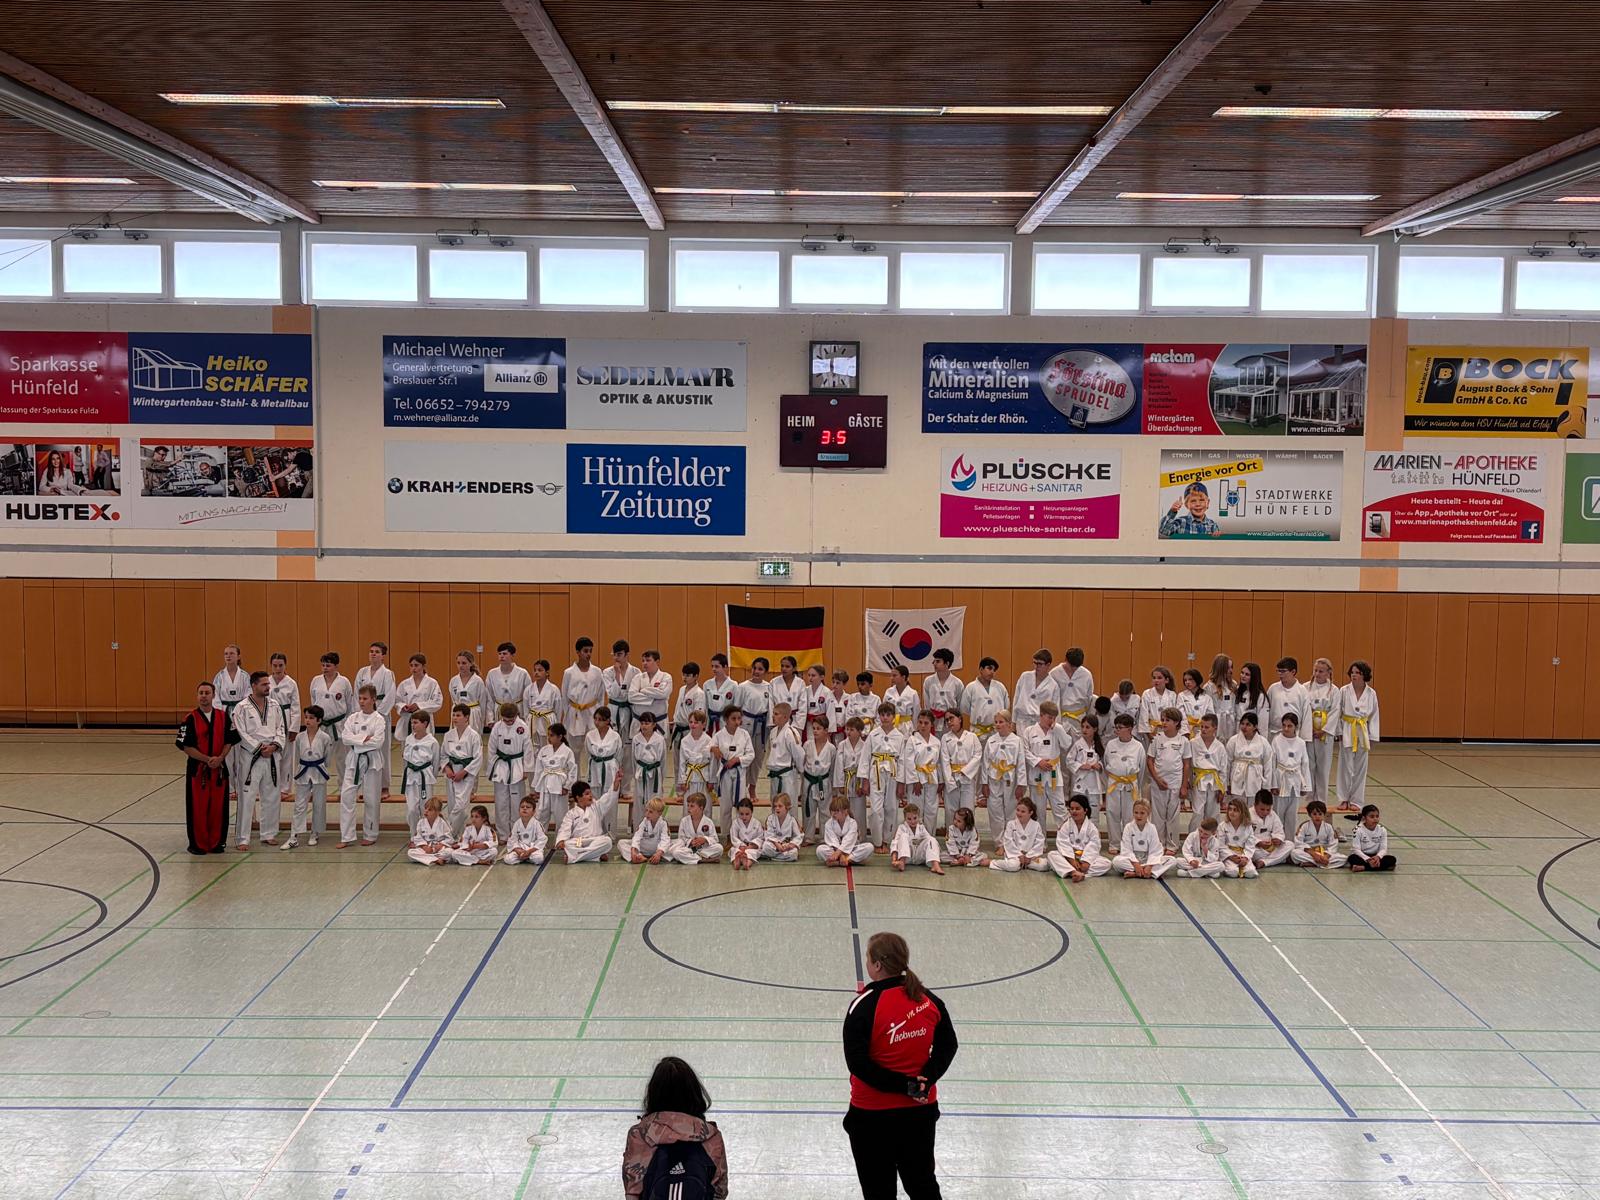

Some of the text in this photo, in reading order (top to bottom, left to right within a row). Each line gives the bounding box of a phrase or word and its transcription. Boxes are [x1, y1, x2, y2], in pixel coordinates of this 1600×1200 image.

[393, 342, 505, 358] Michael Wehner
[1151, 349, 1195, 363] metam
[9, 356, 98, 374] Sparkasse
[206, 355, 269, 372] Heiko
[392, 363, 473, 375] Generalvertretung
[929, 358, 1030, 369] Mit den wertvollen
[1464, 358, 1578, 380] BOCK
[393, 375, 437, 385] Breslauer
[495, 373, 532, 383] Allianz
[576, 365, 735, 388] SEDELMAYR
[928, 369, 1029, 388] Mineralien
[11, 379, 79, 395] Hünfeld
[204, 374, 309, 393] SCHÄFER
[1459, 385, 1554, 394] August Bock & Sohn
[599, 393, 713, 405] OPTIK & AKUSTIK
[928, 389, 1029, 402] Calcium & Magnesium
[1055, 383, 1110, 410] SPRUDEL
[1456, 396, 1486, 405] GmbH
[1495, 397, 1511, 405] Co.
[1513, 397, 1528, 405] KG
[132, 397, 309, 408] Wintergartenbau Stahl- & Metallbau
[393, 398, 413, 410] Tel.
[42, 407, 79, 415] Sparkasse
[393, 413, 480, 423] m.wehner@allianz.de
[787, 415, 815, 427] HEIM
[848, 413, 883, 428] GÄSTE
[927, 413, 1028, 423] Der Schatz der Rhön.
[1147, 414, 1195, 423] Wintergärten
[1147, 422, 1203, 434] Überdachungen
[582, 455, 731, 487] Hünfelder
[982, 458, 1112, 480] PLÜSCHKE
[1168, 460, 1258, 484] Energie vor Ort
[1452, 471, 1521, 486] HÜNFELD
[1255, 489, 1333, 501] STADTWERKE
[1410, 497, 1433, 505] Heute
[1434, 497, 1461, 505] bestellt
[600, 489, 713, 527] Zeitung
[1255, 502, 1332, 516] HÜNFELD
[1415, 510, 1430, 518] App
[178, 510, 197, 521] MIT
[1394, 518, 1518, 527] www.marienapothekehuenfeld.de
[963, 525, 1096, 534] www.plueschke-sanitaer.de
